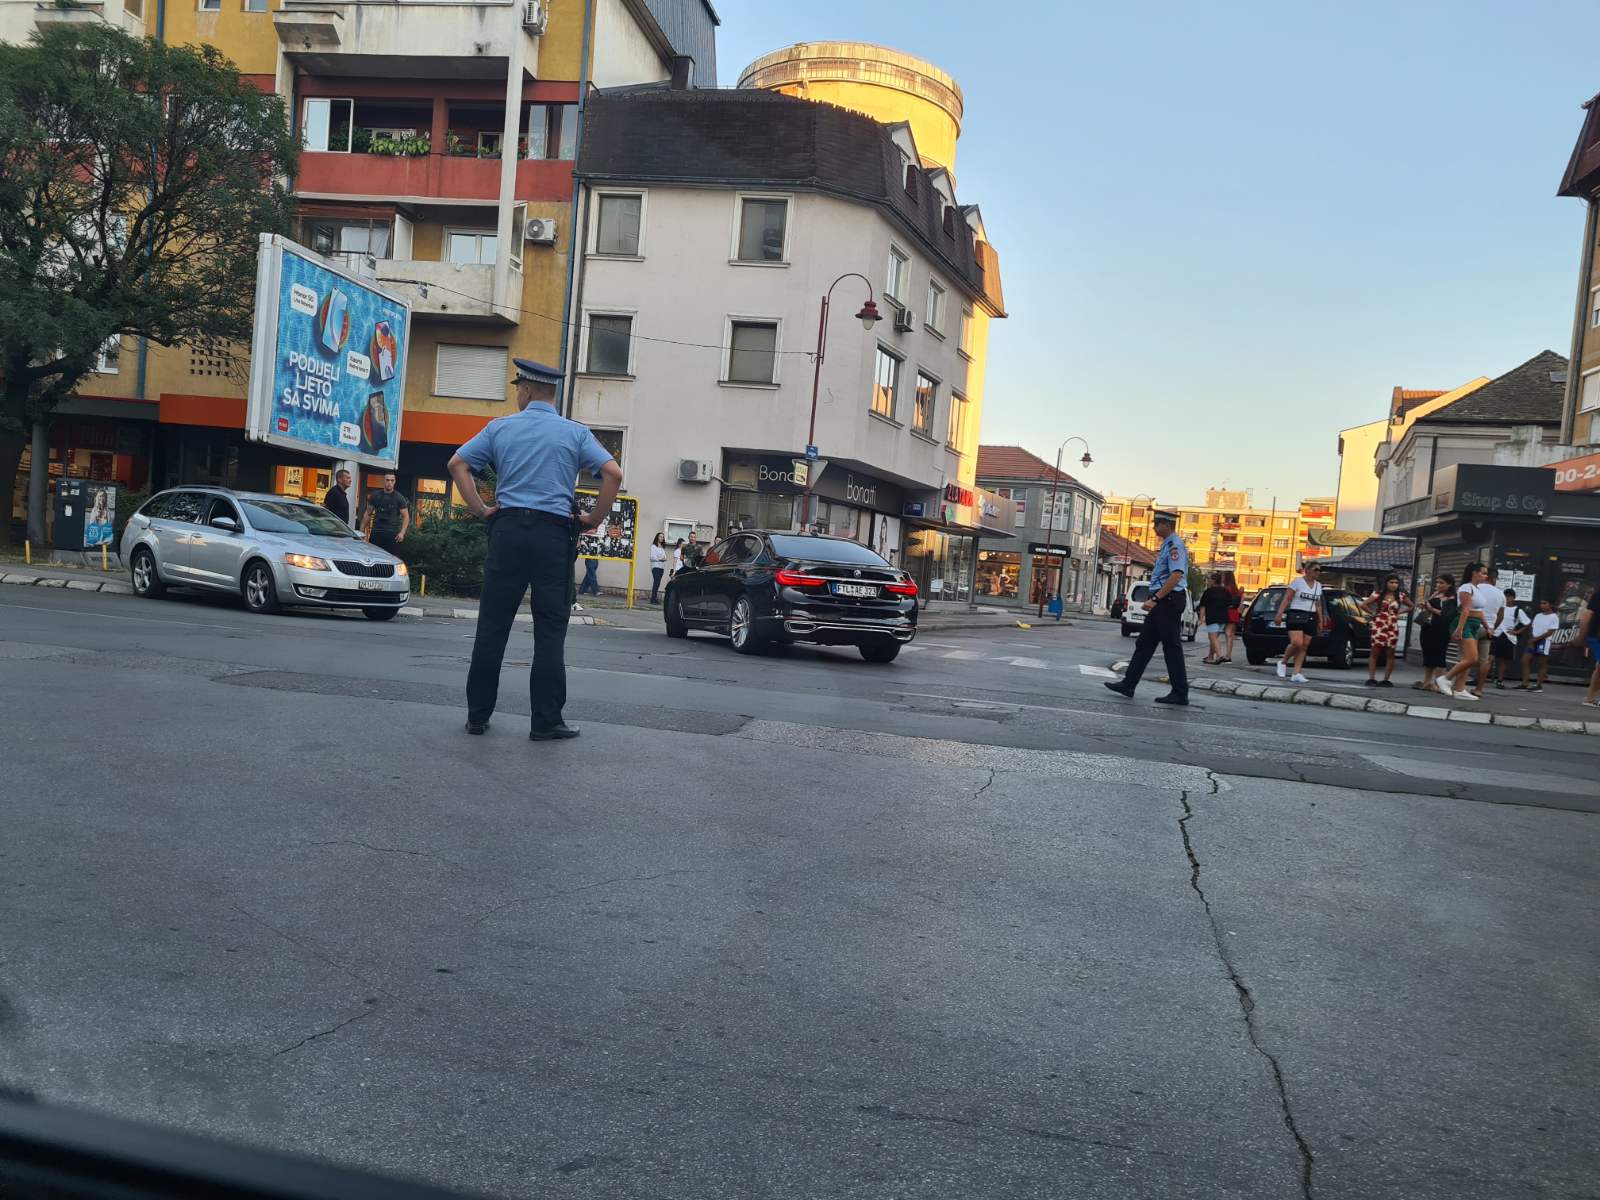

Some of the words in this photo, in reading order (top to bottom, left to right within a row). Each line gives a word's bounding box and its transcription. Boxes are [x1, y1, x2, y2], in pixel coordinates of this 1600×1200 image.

[289, 351, 341, 381] PODIJELI
[296, 371, 332, 397] LJETO
[283, 388, 300, 407] SA
[302, 394, 340, 417] SVIMA
[847, 474, 877, 505] Bonatti
[1505, 494, 1518, 509] &
